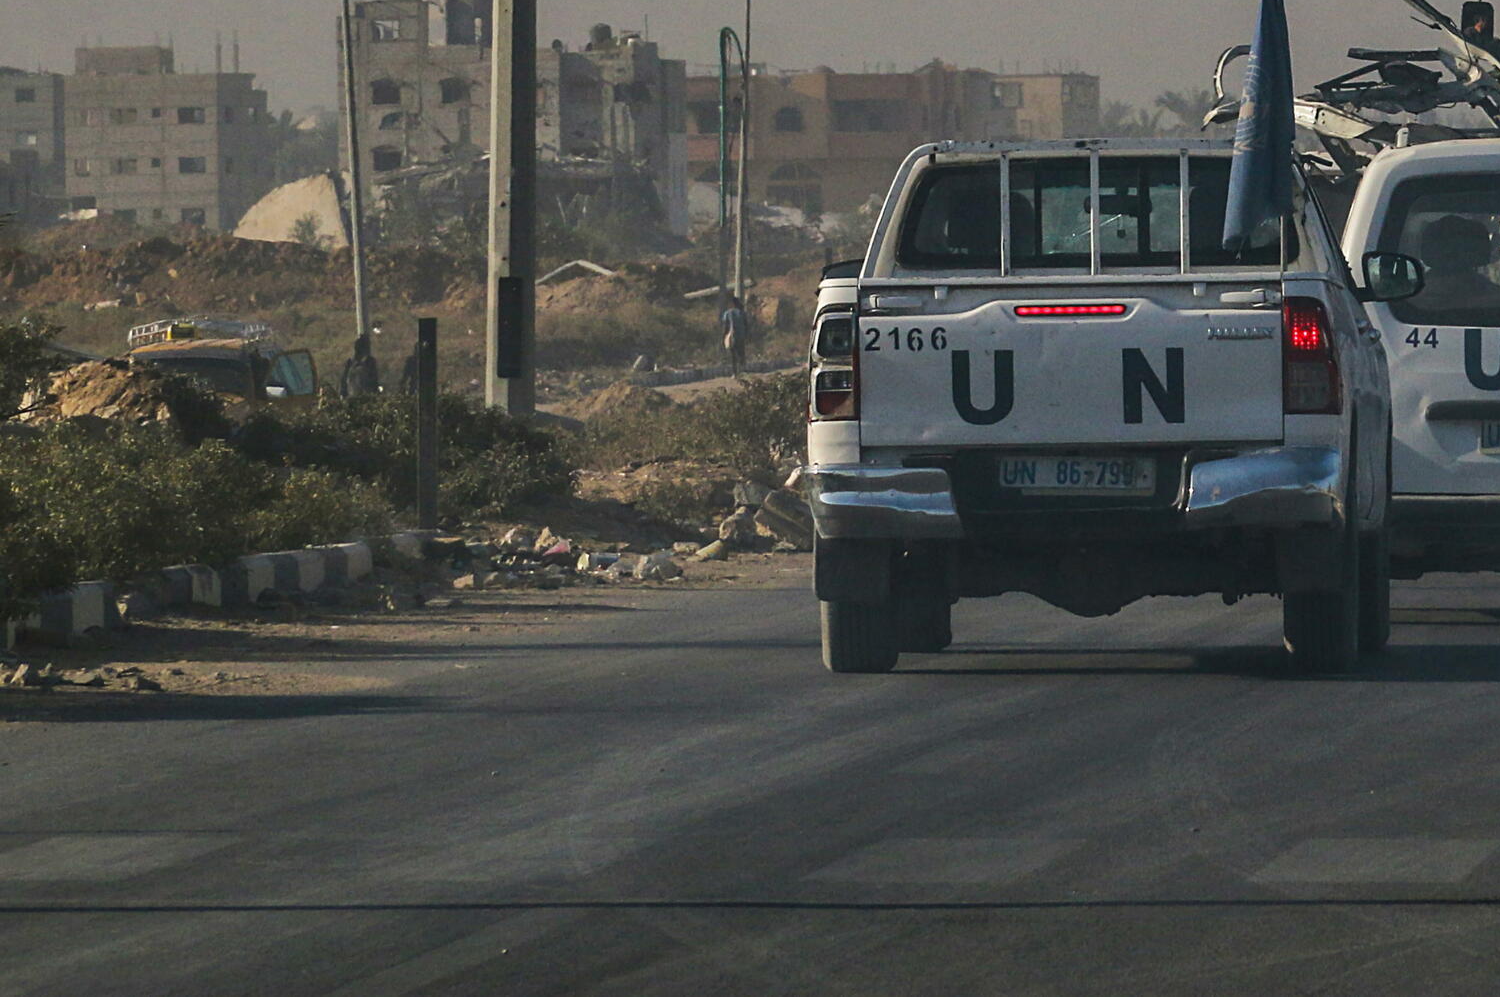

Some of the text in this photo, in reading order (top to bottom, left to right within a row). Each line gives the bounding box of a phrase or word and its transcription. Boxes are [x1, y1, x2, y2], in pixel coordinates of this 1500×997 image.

[864, 327, 947, 352] 2166
[1405, 328, 1439, 348] 44
[1003, 461, 1036, 485] UN
